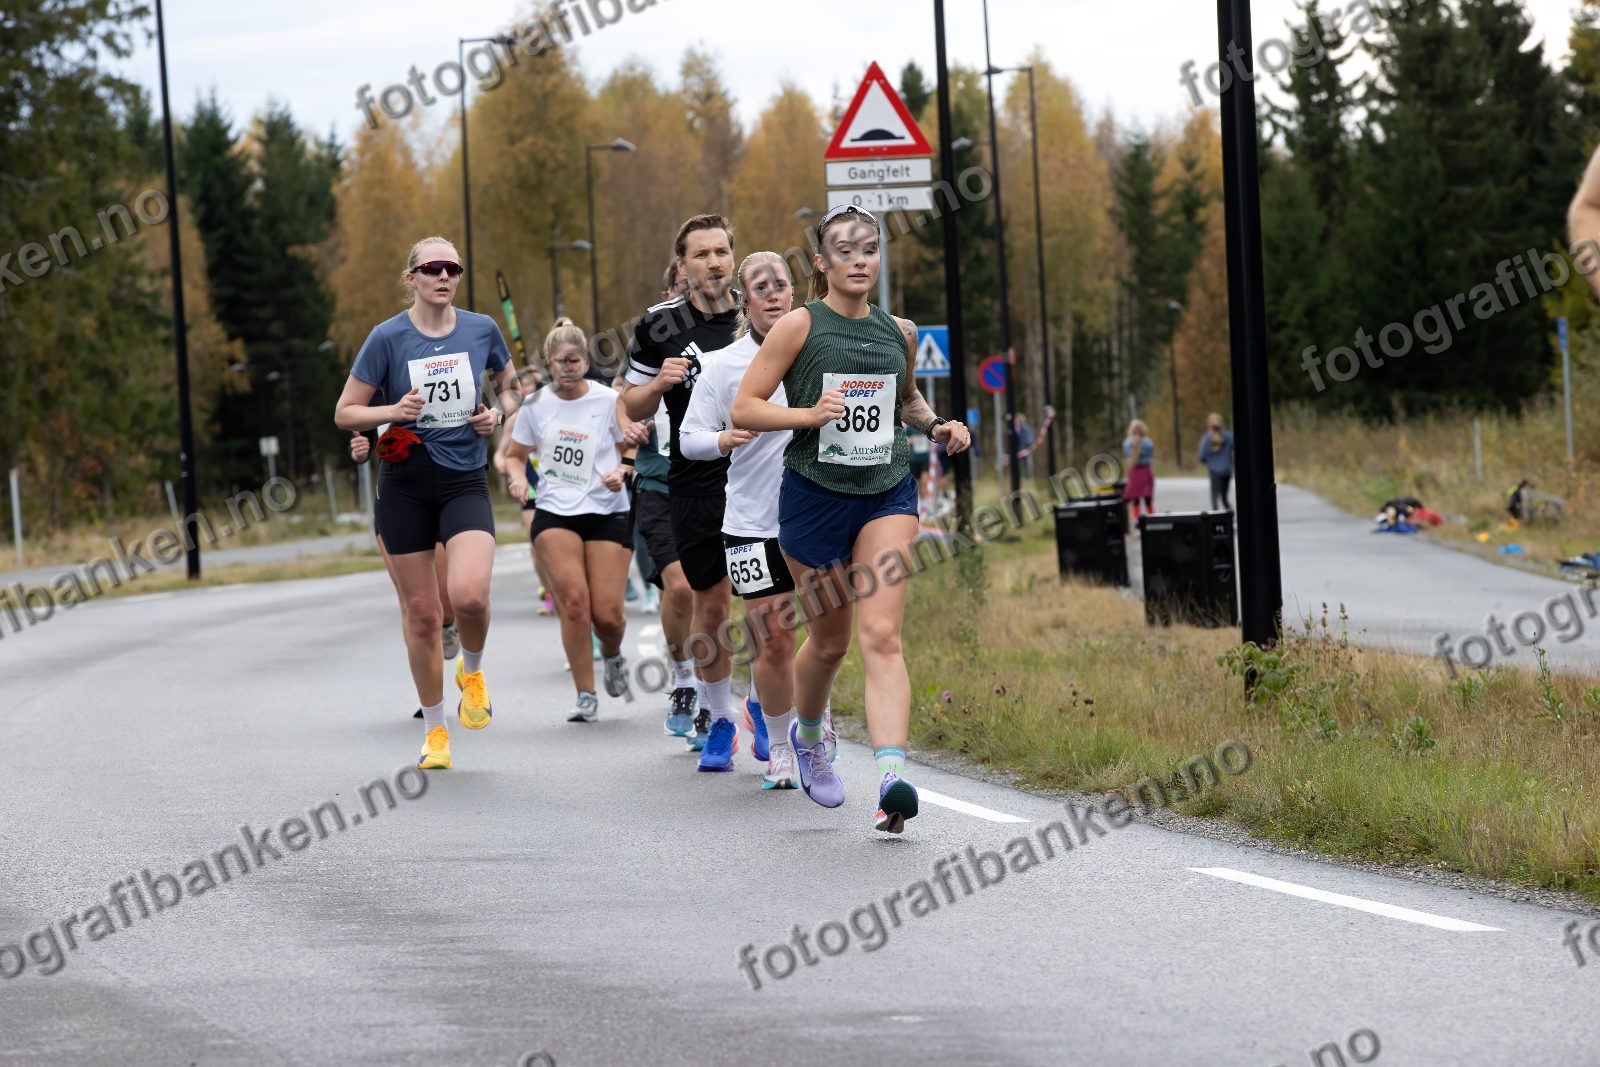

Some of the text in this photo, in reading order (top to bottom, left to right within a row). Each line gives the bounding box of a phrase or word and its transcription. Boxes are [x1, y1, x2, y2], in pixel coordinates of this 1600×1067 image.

[848, 165, 911, 181] Gangfelt
[887, 192, 909, 207] km
[424, 359, 459, 370] NORGES
[427, 366, 454, 376] LØPET
[841, 380, 885, 389] NORGES
[424, 378, 461, 404] 731
[844, 389, 877, 397] LØPET
[441, 407, 474, 419] Aurskog
[835, 405, 881, 433] 368
[553, 445, 584, 467] 509
[850, 444, 891, 456] Aurskog
[730, 544, 753, 555] LØPET
[730, 557, 763, 585] 653
